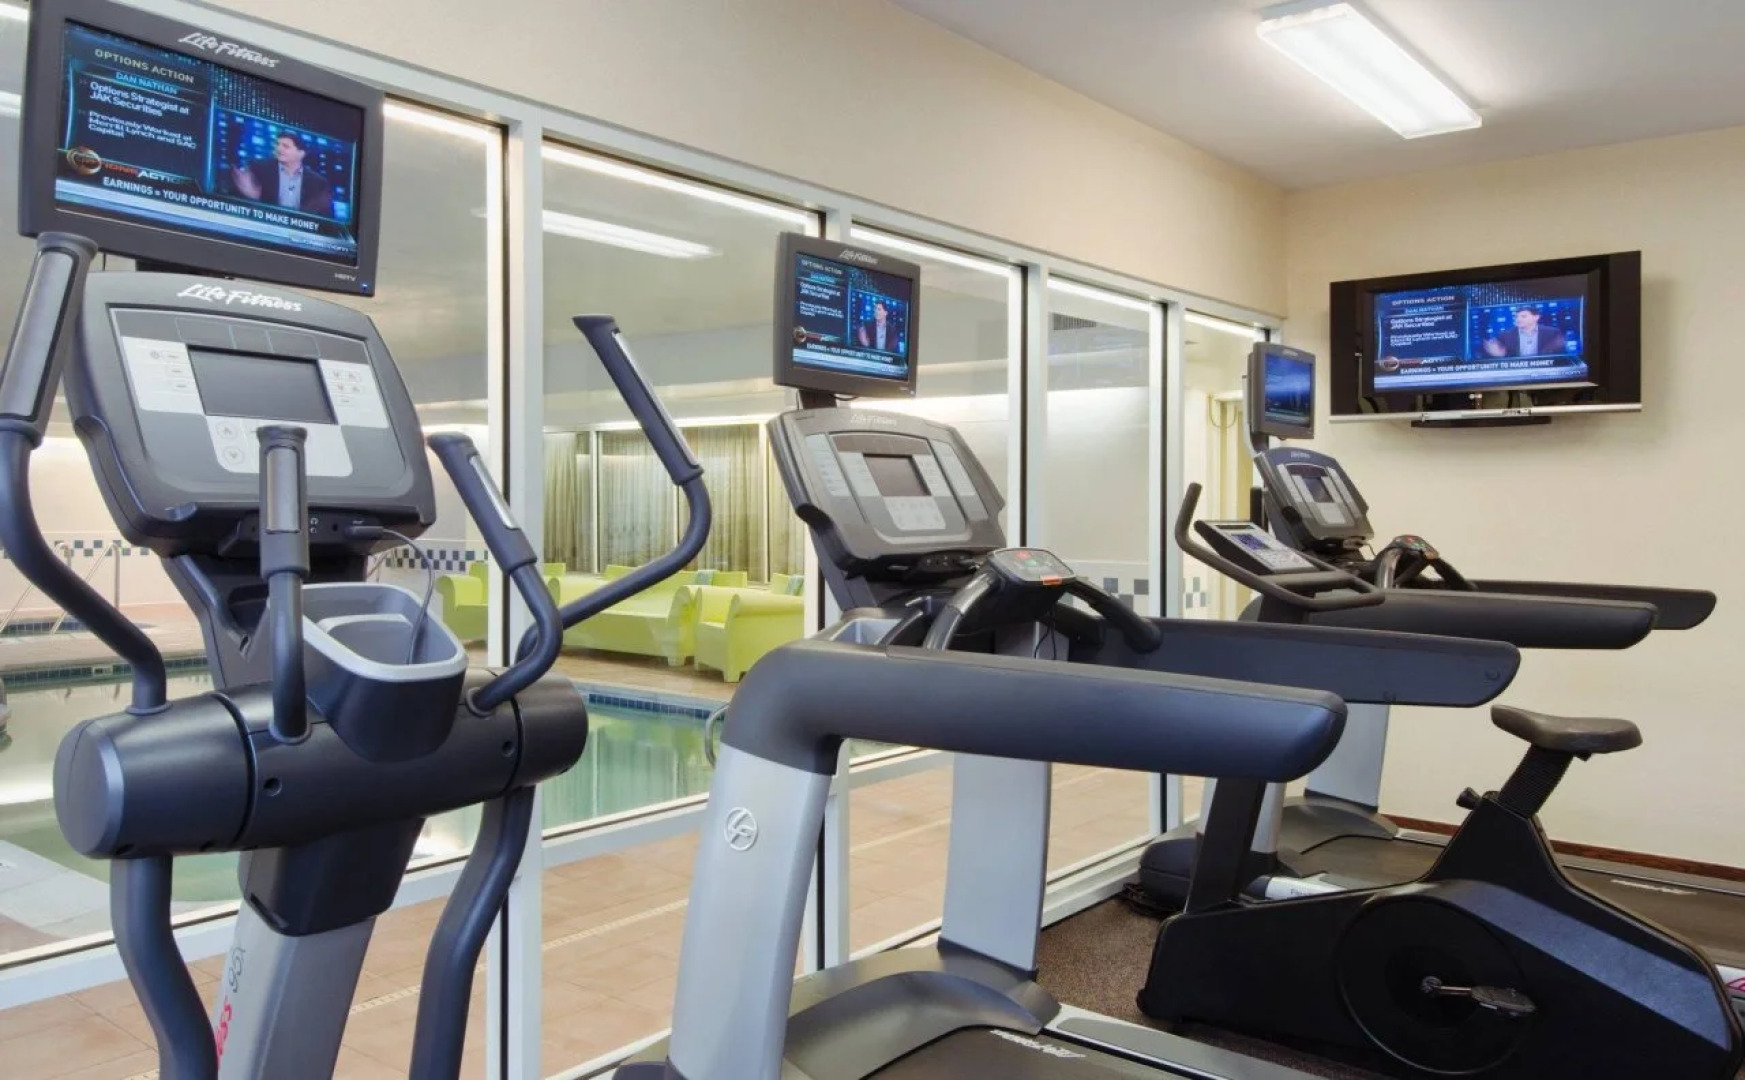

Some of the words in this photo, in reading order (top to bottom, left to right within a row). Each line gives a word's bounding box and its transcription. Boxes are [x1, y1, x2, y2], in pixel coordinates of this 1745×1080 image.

[94, 48, 150, 71] OPTIONS
[151, 65, 194, 84] ACTION
[116, 71, 137, 84] DAN
[138, 78, 178, 95] NATHAN
[89, 91, 112, 103] JAK
[112, 97, 163, 117] Securities
[90, 81, 130, 99] Options
[130, 92, 178, 112] Strategist
[179, 106, 190, 115] at
[103, 176, 153, 196] EARNINGS
[162, 188, 188, 203] YOUR
[190, 196, 251, 217] OPPORTUNITY
[252, 208, 264, 219] TO
[265, 212, 289, 225] MAKE
[289, 217, 320, 232] MONEY
[225, 290, 302, 312] Fitness
[1426, 295, 1455, 303] ACTION
[1437, 365, 1454, 373] YOUR
[1510, 360, 1529, 368] MAKE
